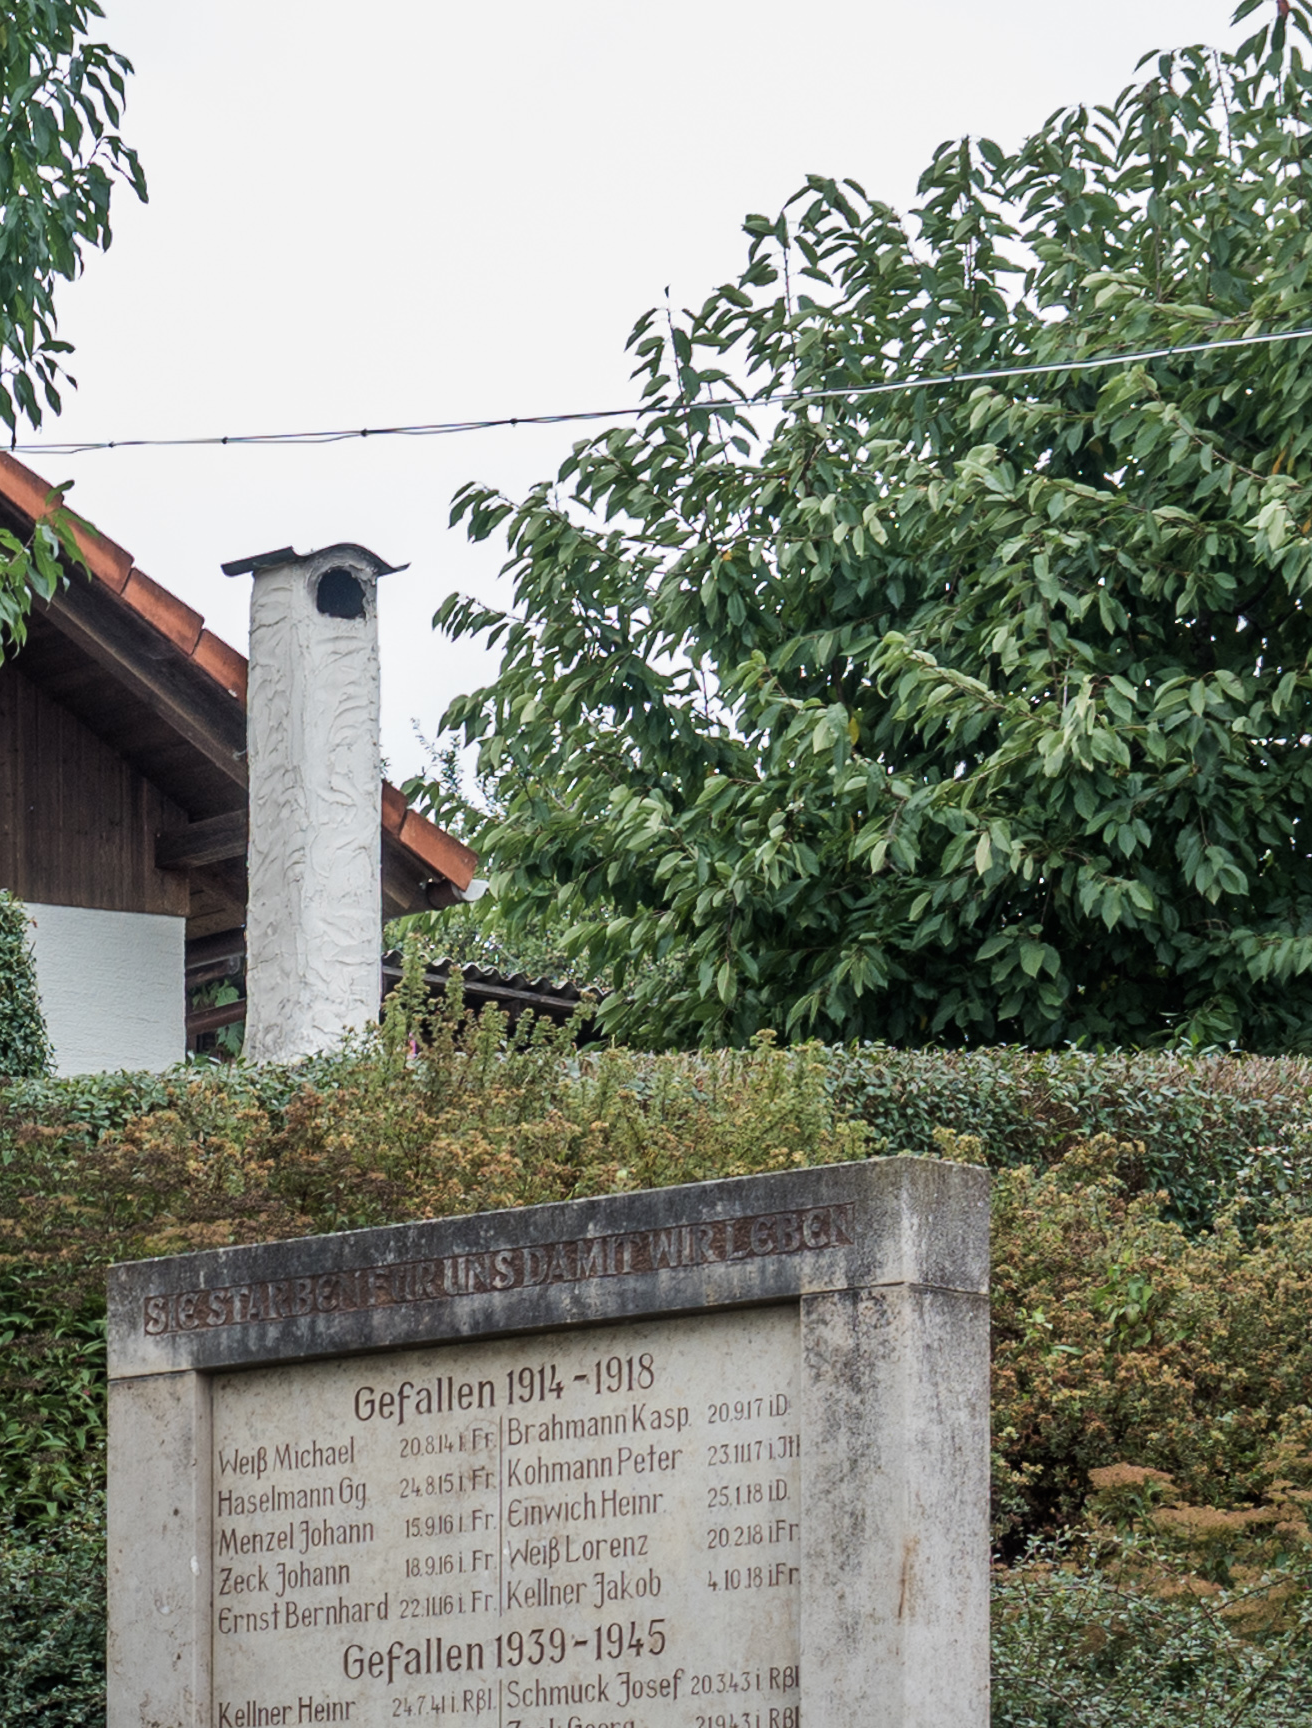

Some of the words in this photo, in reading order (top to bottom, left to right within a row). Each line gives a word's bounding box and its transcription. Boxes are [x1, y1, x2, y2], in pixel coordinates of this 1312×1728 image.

[145, 1293, 199, 1334] SIE
[443, 1250, 515, 1297] UNS
[526, 1233, 639, 1285] DAMIT
[649, 1221, 719, 1268] WIR
[725, 1203, 855, 1258] LEBEN
[353, 1376, 496, 1426] Gefallen
[508, 1408, 627, 1445] Brahmann
[633, 1403, 691, 1433] Kasp.
[219, 1447, 267, 1480] Weiß
[273, 1436, 354, 1471] Michael
[508, 1456, 612, 1487] Kohmann
[618, 1444, 683, 1476] Peter
[218, 1485, 334, 1517] Haselmann
[508, 1492, 596, 1527] Einwich
[219, 1522, 293, 1556] Menzel
[299, 1519, 373, 1555] Johann
[508, 1536, 560, 1570] Weiß
[566, 1535, 648, 1563] Lorenz
[219, 1565, 269, 1596] Zeck
[275, 1561, 350, 1598] Johann
[507, 1578, 587, 1610] Kellner
[593, 1568, 661, 1609] Jakob
[218, 1603, 280, 1634] Ernst
[285, 1592, 388, 1629] Bernhard
[342, 1637, 485, 1686] Gefallen
[507, 1674, 609, 1708] Schmuck
[616, 1668, 685, 1708] Josef
